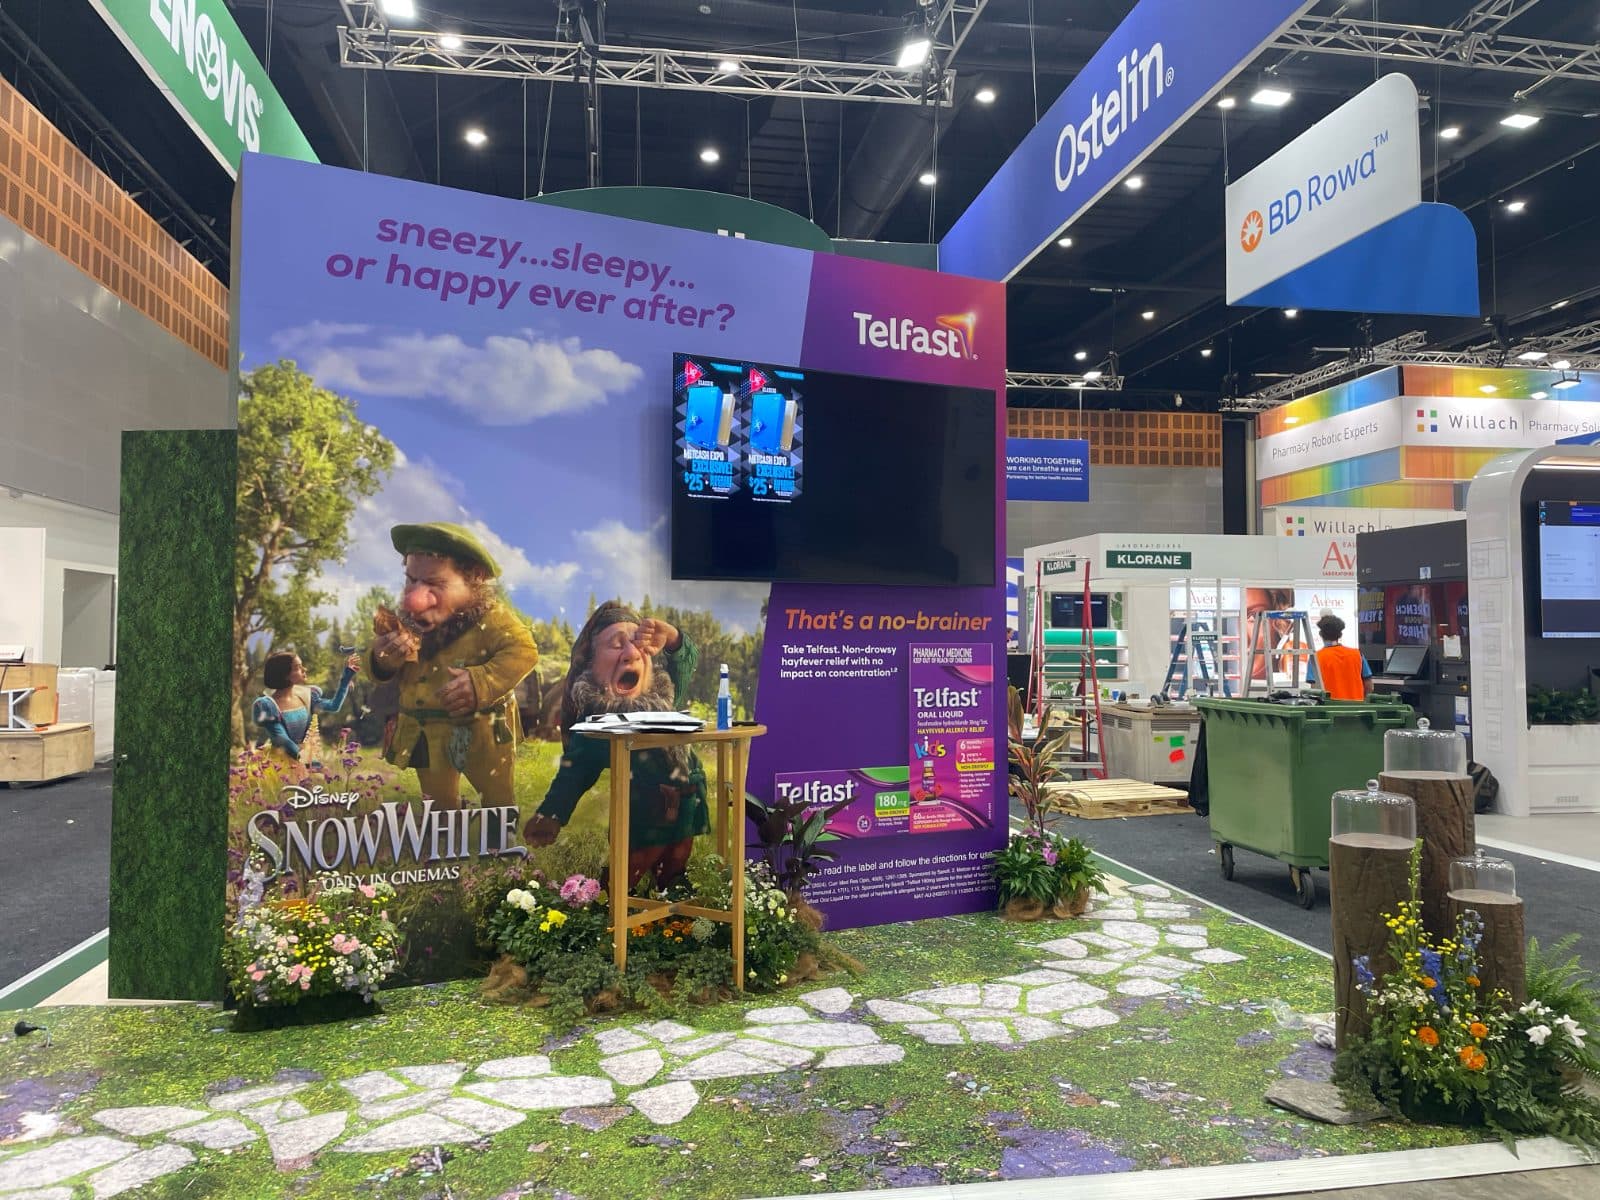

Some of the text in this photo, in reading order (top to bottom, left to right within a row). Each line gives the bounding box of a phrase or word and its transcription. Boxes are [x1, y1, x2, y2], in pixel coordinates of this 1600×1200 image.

[1268, 189, 1301, 236] BD
[326, 253, 736, 332] or happy ever after?
[853, 311, 961, 360] Telfast
[1449, 414, 1518, 430] Willach
[1528, 420, 1579, 433] Pharmacy
[1272, 421, 1379, 460] Pharmacy Robotic Experts
[1006, 456, 1042, 464] WORKING
[1314, 521, 1375, 534] Willach
[1116, 555, 1182, 566] KLORANE
[785, 608, 992, 632] That's a no-brainer
[782, 644, 897, 656] Take Telfast. Non-drowsy
[913, 647, 973, 658] PHARMACY MEDICINE
[781, 656, 884, 668] hayfever relief with no
[779, 669, 813, 680] impact
[814, 670, 827, 678] on
[913, 687, 978, 708] Telfast
[917, 710, 964, 719] ORAL LIQUID
[913, 735, 946, 759] kids
[960, 753, 966, 763] 2
[824, 865, 842, 875] read
[844, 863, 857, 873] the
[858, 861, 877, 872] label
[878, 860, 894, 869] and
[895, 858, 916, 868] follow
[918, 857, 930, 865] the
[931, 854, 967, 865] directions
[968, 851, 979, 860] for
[390, 865, 460, 886] CINEMAS
